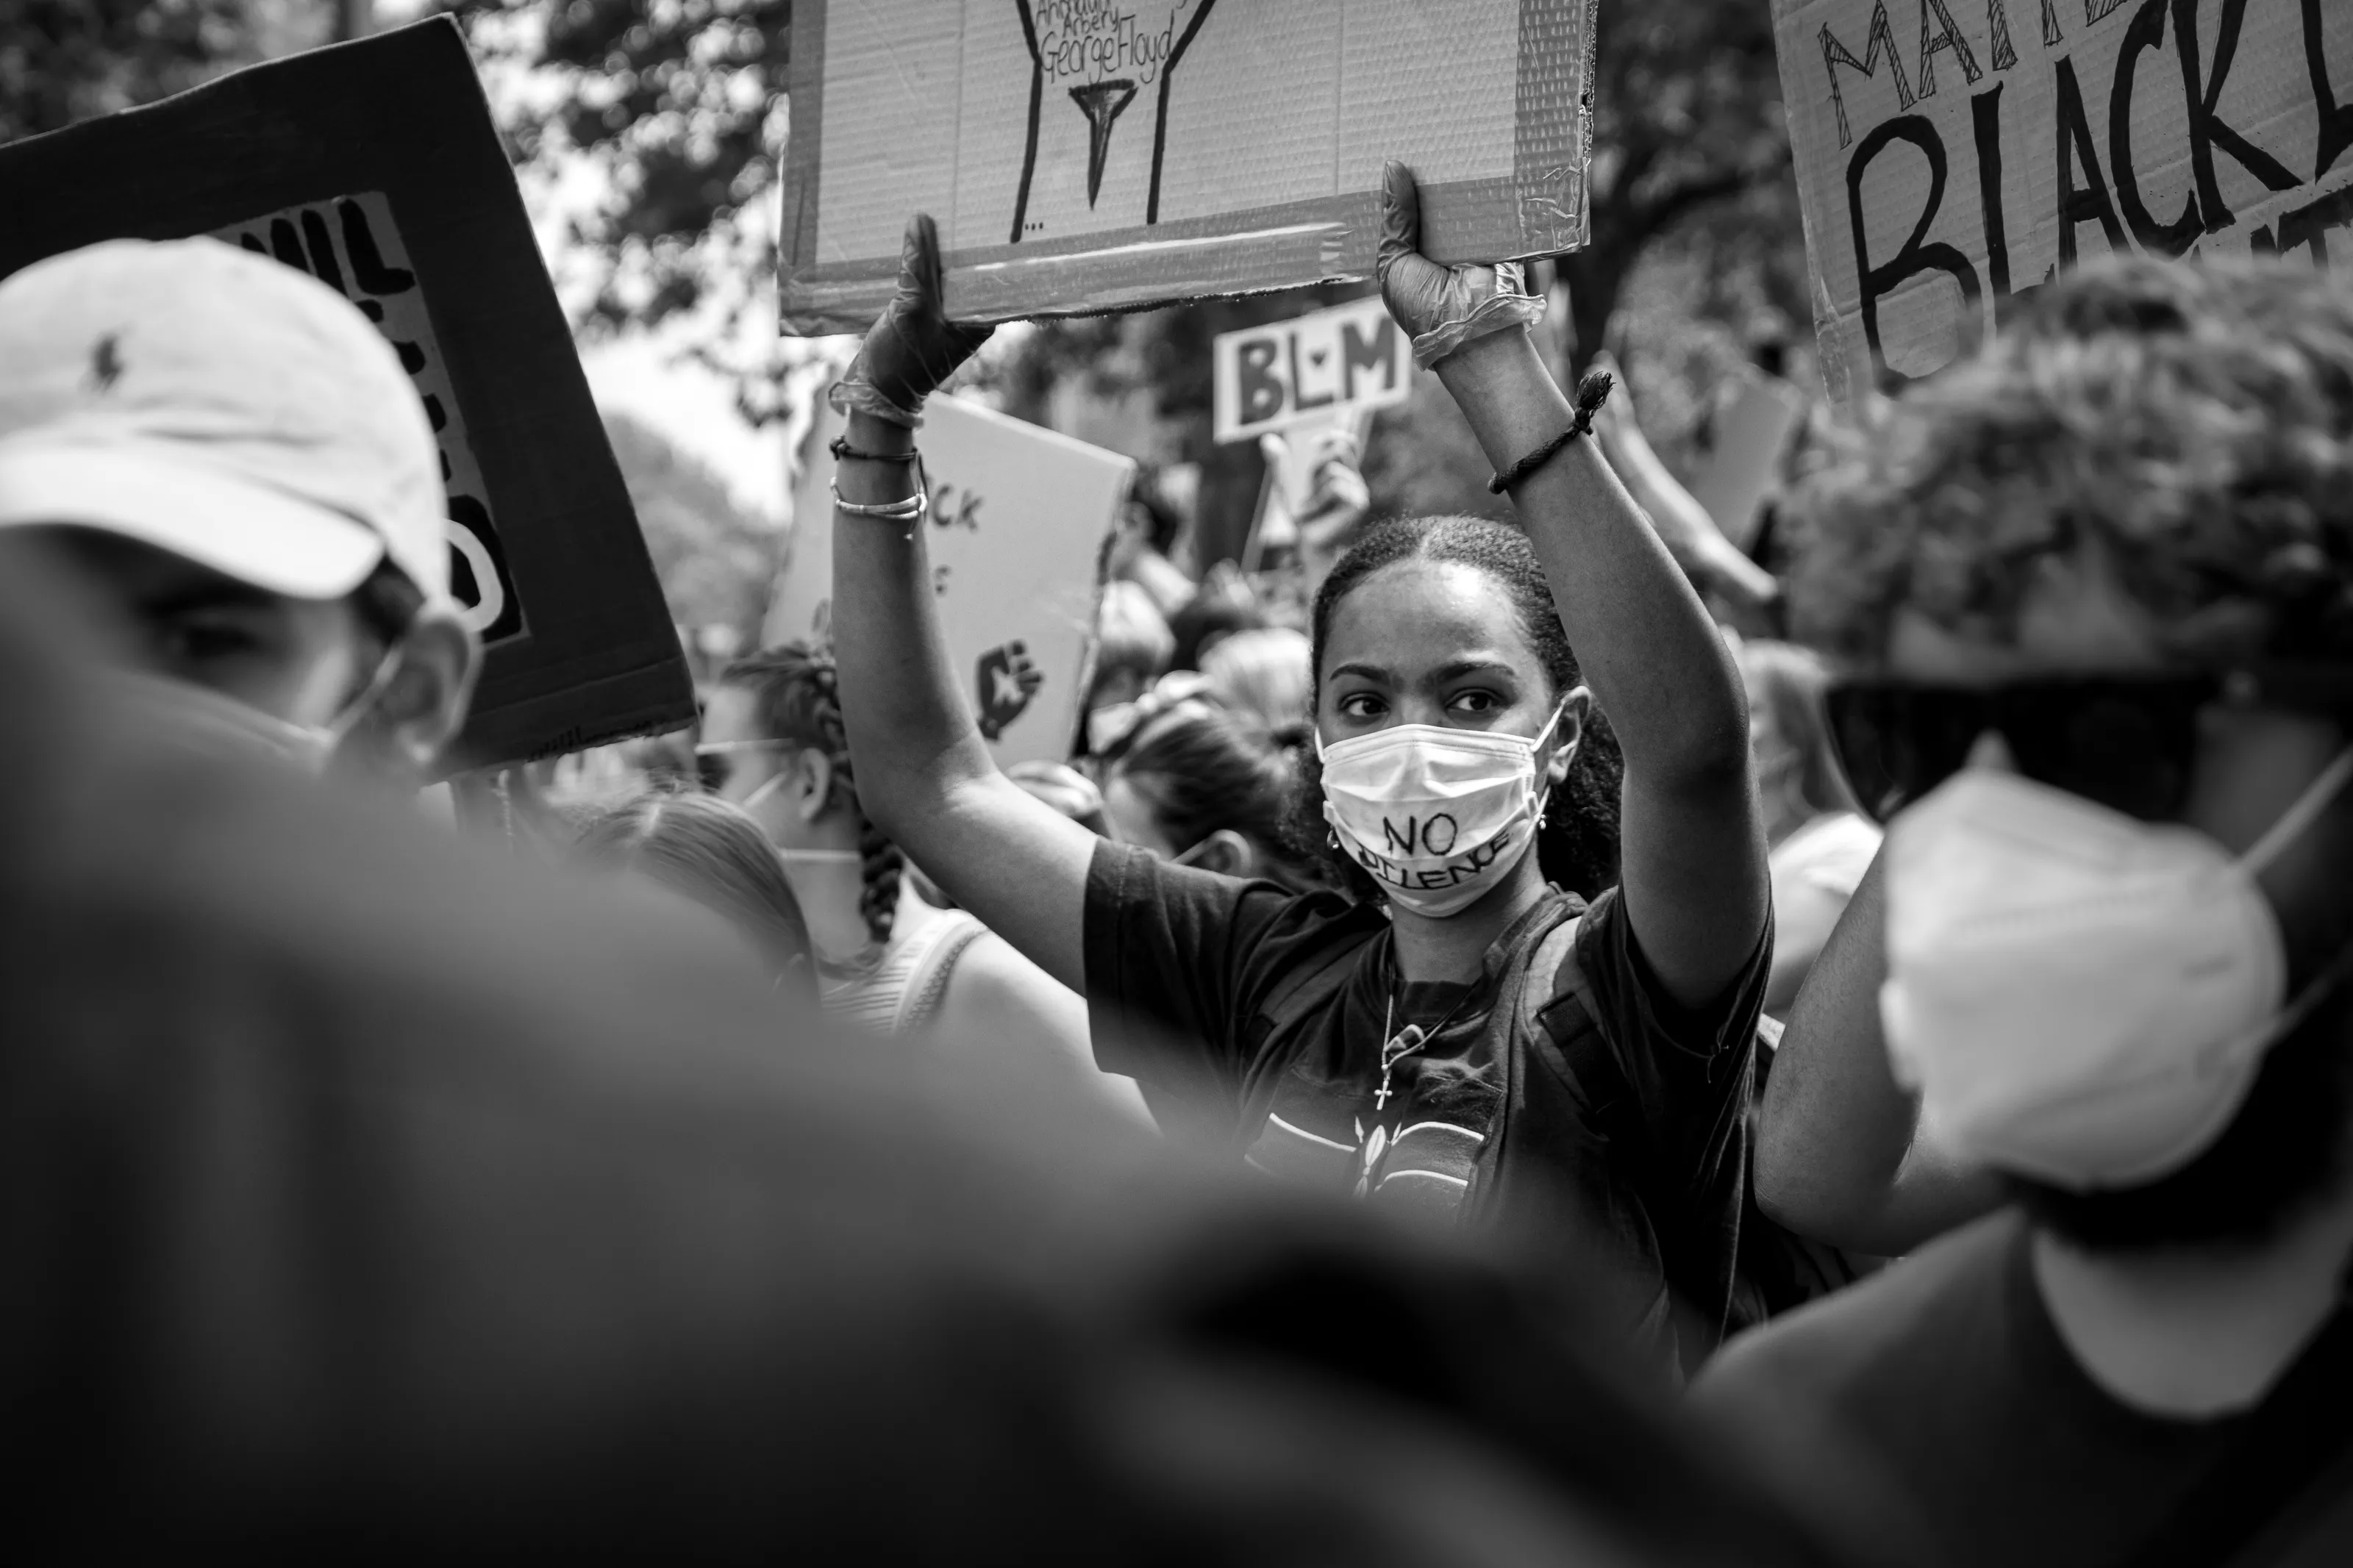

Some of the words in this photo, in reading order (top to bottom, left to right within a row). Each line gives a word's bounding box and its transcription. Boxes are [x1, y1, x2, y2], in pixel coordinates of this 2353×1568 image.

[1041, 31, 1118, 85] George
[1117, 9, 1175, 85] Floyd
[1846, 0, 2304, 398] BLACK
[1238, 313, 1396, 425] BLM
[1383, 813, 1457, 856] NO
